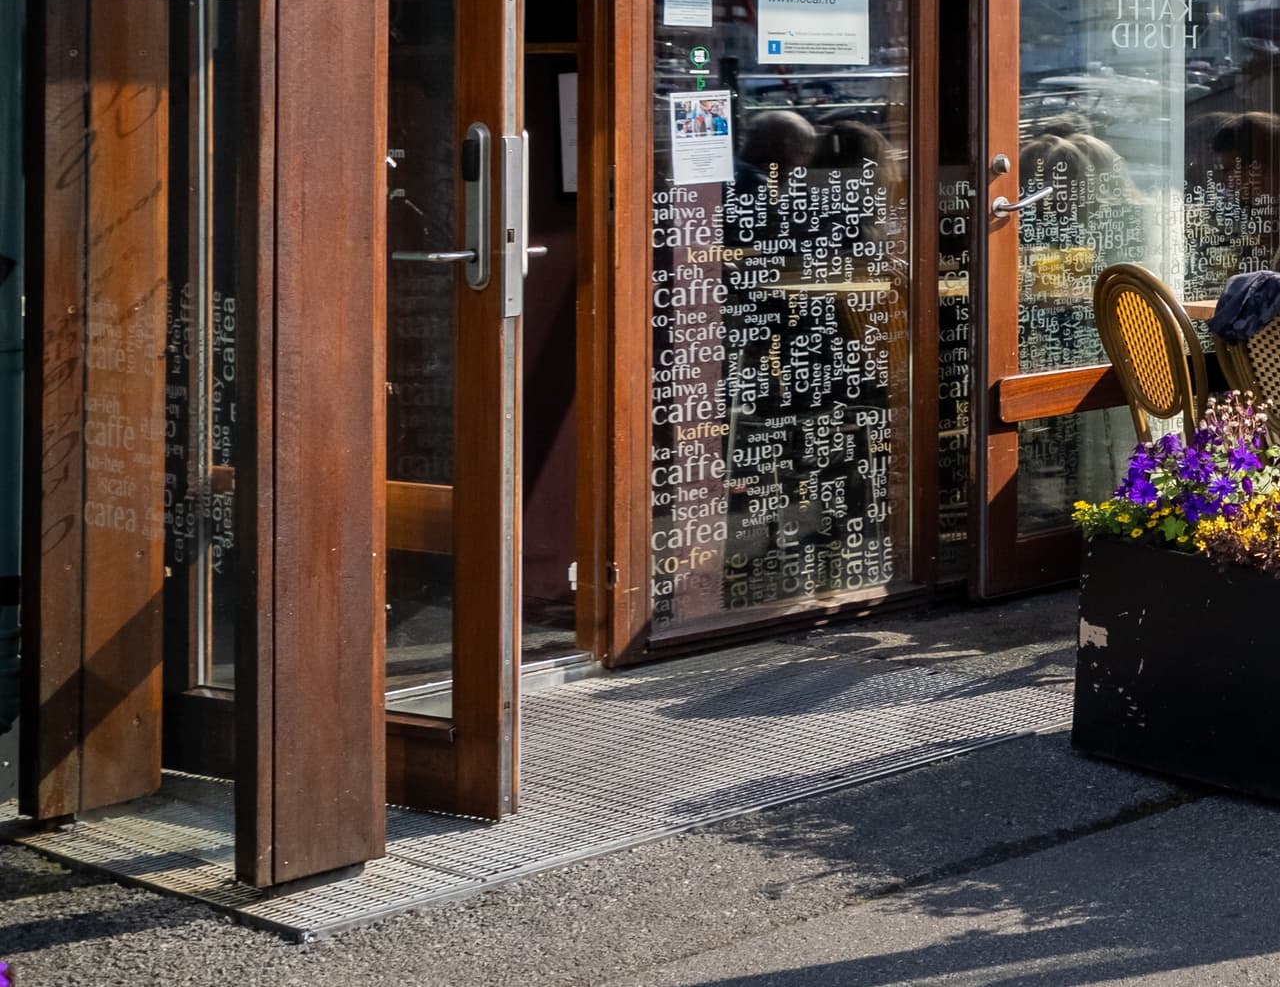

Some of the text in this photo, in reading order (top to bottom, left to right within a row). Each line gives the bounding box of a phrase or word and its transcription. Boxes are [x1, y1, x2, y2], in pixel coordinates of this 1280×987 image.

[767, 162, 779, 205] coffee
[788, 166, 807, 224] caffè
[819, 188, 829, 218] kawa
[860, 157, 878, 217] ko-fey
[1052, 161, 1068, 213] caffè
[755, 184, 767, 227] kaffee
[808, 186, 820, 232] ko-hee
[842, 179, 859, 238] cafea
[874, 187, 887, 225] kaffe
[652, 219, 711, 248] café
[687, 246, 744, 264] kaffee
[829, 222, 845, 276] ko-fey
[654, 278, 728, 308] caffè
[730, 269, 780, 290] caffè
[720, 303, 757, 316] coffee
[808, 296, 826, 354] ko-fey
[219, 298, 236, 382] cafea
[668, 321, 727, 343] iscafé
[861, 325, 880, 381] ko-fey
[660, 342, 725, 366] cafea
[768, 334, 781, 377] coffee
[790, 335, 809, 393] caffè
[830, 337, 843, 381] iscafé
[843, 339, 860, 398] cafea
[876, 350, 889, 388] kaffe
[758, 356, 769, 398] kaffee
[810, 362, 822, 407] ko-hee
[652, 394, 712, 425] café
[830, 401, 848, 452] ko-fey
[652, 441, 704, 461] ka-feh
[676, 422, 730, 441] kaffee
[815, 415, 830, 468] cafea
[652, 452, 726, 487] caffè
[733, 443, 783, 467] caffè
[652, 487, 708, 506] ko-hee
[671, 497, 729, 521] iscafé
[213, 494, 226, 574] ko-fey
[652, 519, 728, 551] cafea
[841, 517, 863, 590] cafea
